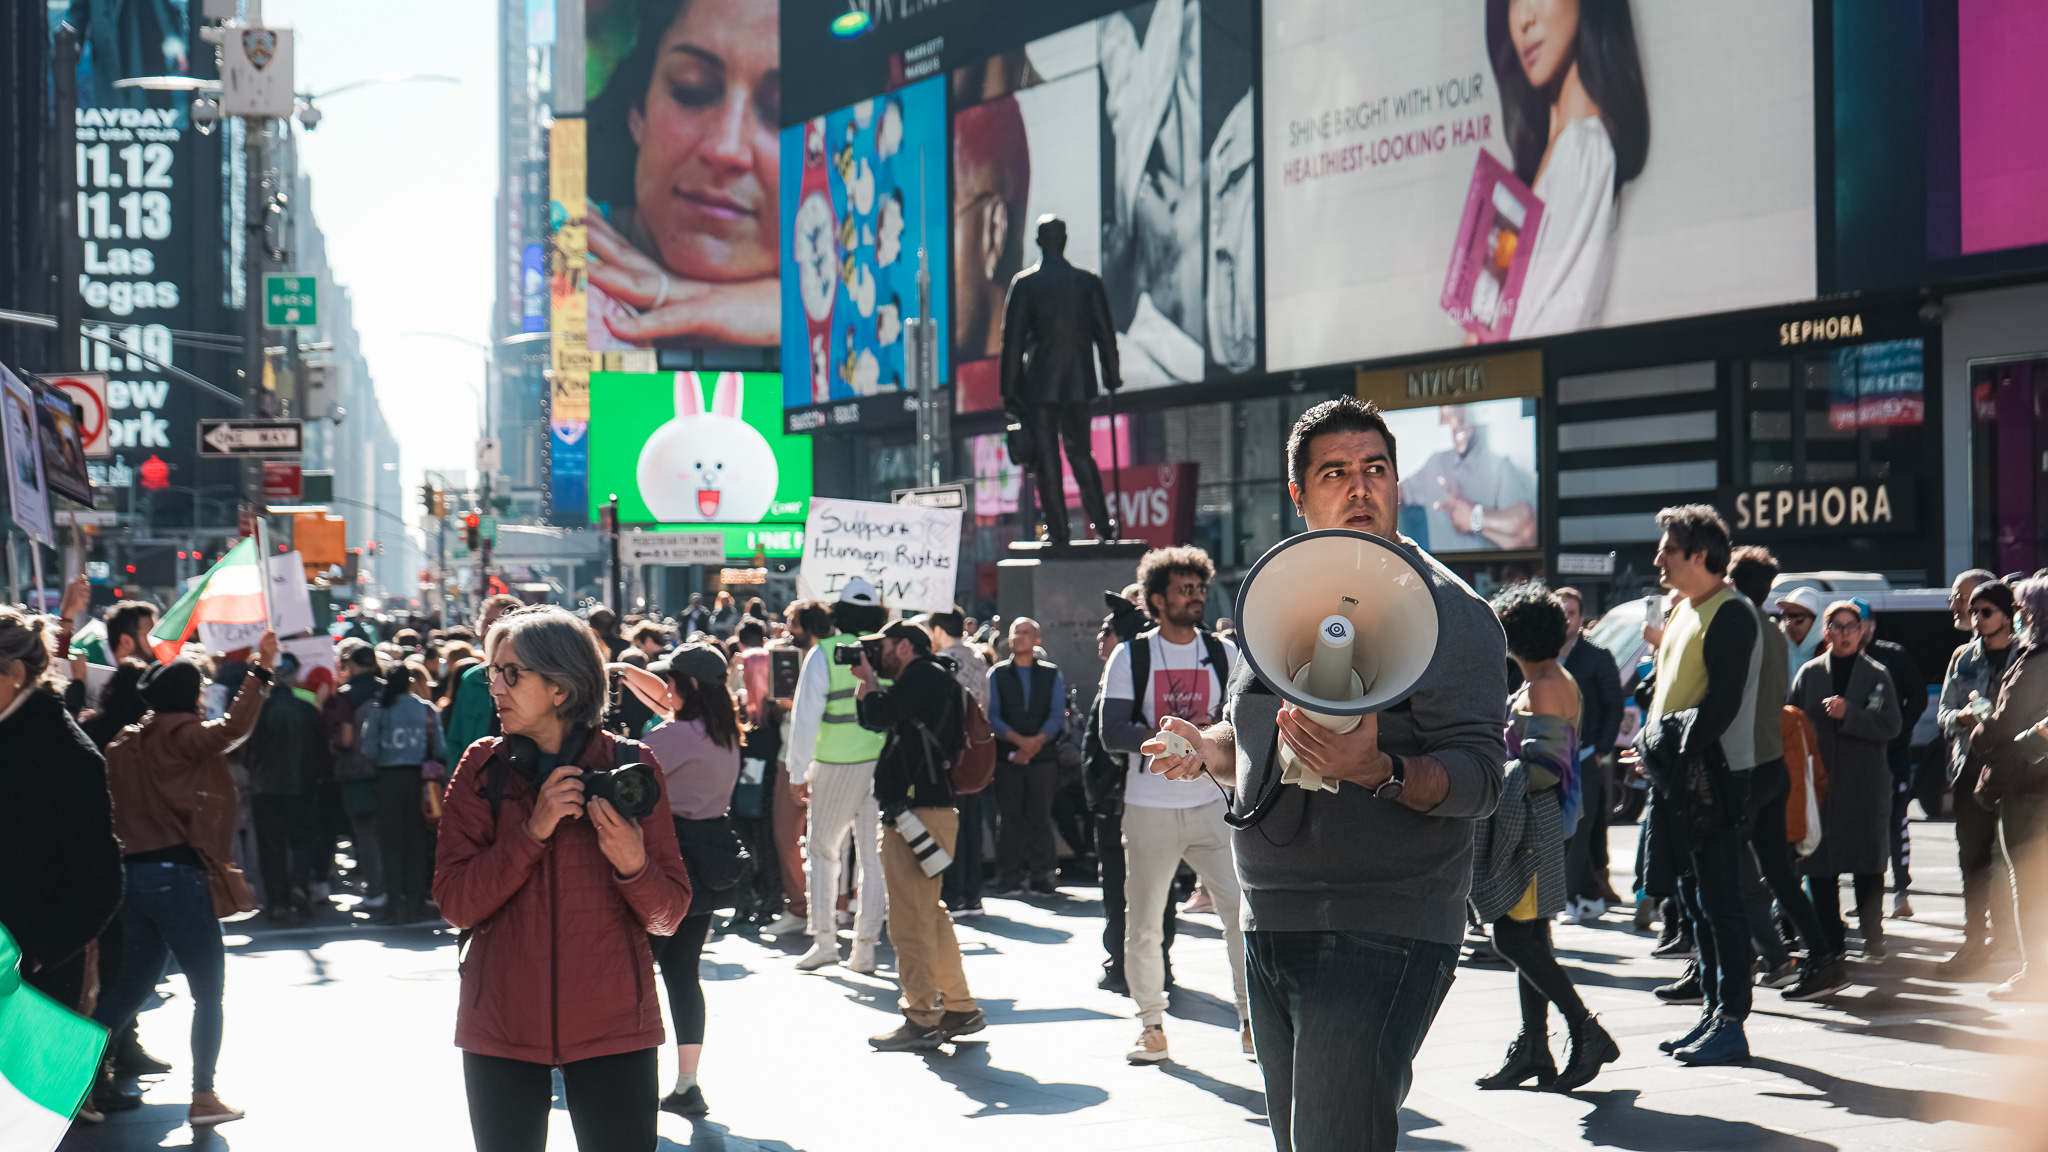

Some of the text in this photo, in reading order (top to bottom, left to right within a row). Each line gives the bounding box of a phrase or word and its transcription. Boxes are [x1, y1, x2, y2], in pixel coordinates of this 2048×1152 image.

[1289, 73, 1484, 147] SHINE BRIGHT WITH YOUR
[1283, 114, 1491, 187] HEALTHIEST-LOOKING HAIR
[84, 241, 155, 275] Las
[79, 274, 180, 316] egas
[1779, 314, 1863, 346] SEPHORA
[107, 380, 170, 409] ew
[1408, 363, 1485, 397] INVICTA
[109, 411, 170, 447] ork
[215, 429, 289, 443] ONE WAY
[820, 507, 909, 540] Support
[1736, 484, 1892, 529] SEPHORA
[814, 538, 885, 561] Human
[896, 544, 951, 569] Rights
[863, 562, 888, 575] for
